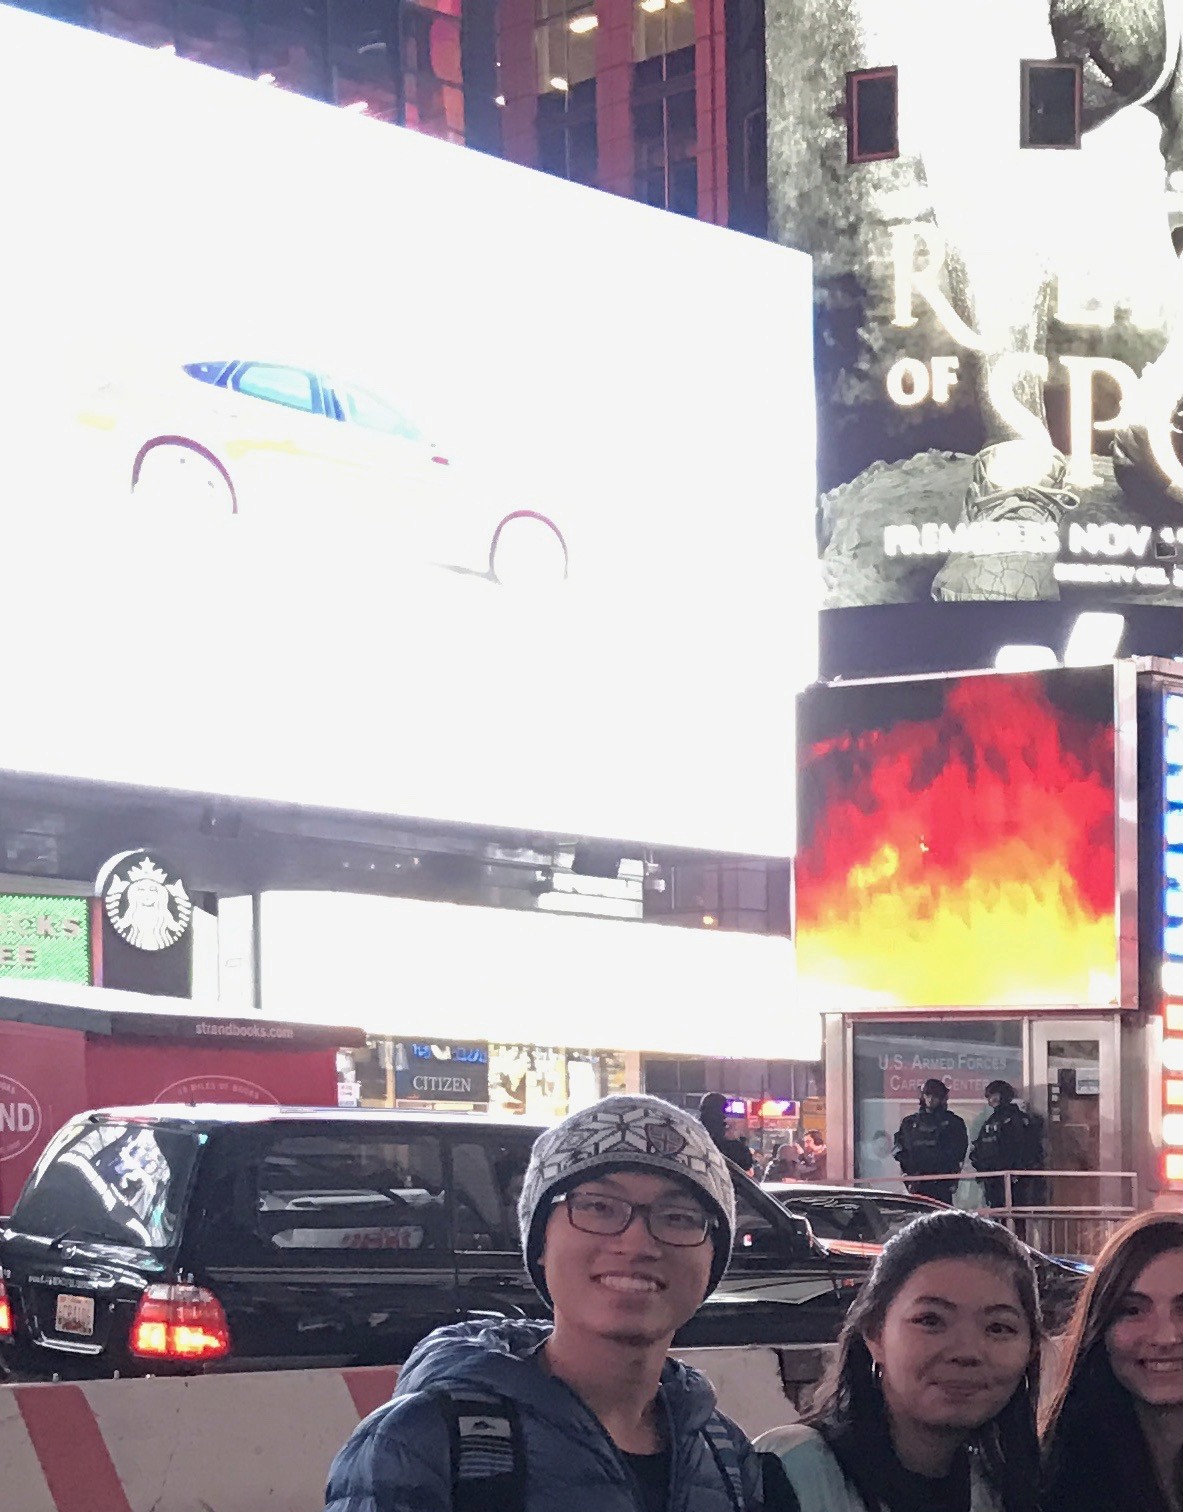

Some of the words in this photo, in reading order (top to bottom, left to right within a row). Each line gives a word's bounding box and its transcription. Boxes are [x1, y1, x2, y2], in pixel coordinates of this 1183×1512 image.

[886, 354, 959, 406] OF
[195, 1021, 294, 1039] strandbooks.com
[911, 1054, 956, 1071] ARMED
[957, 1054, 1008, 1071] FORCES
[412, 1075, 472, 1093] CITIZEN
